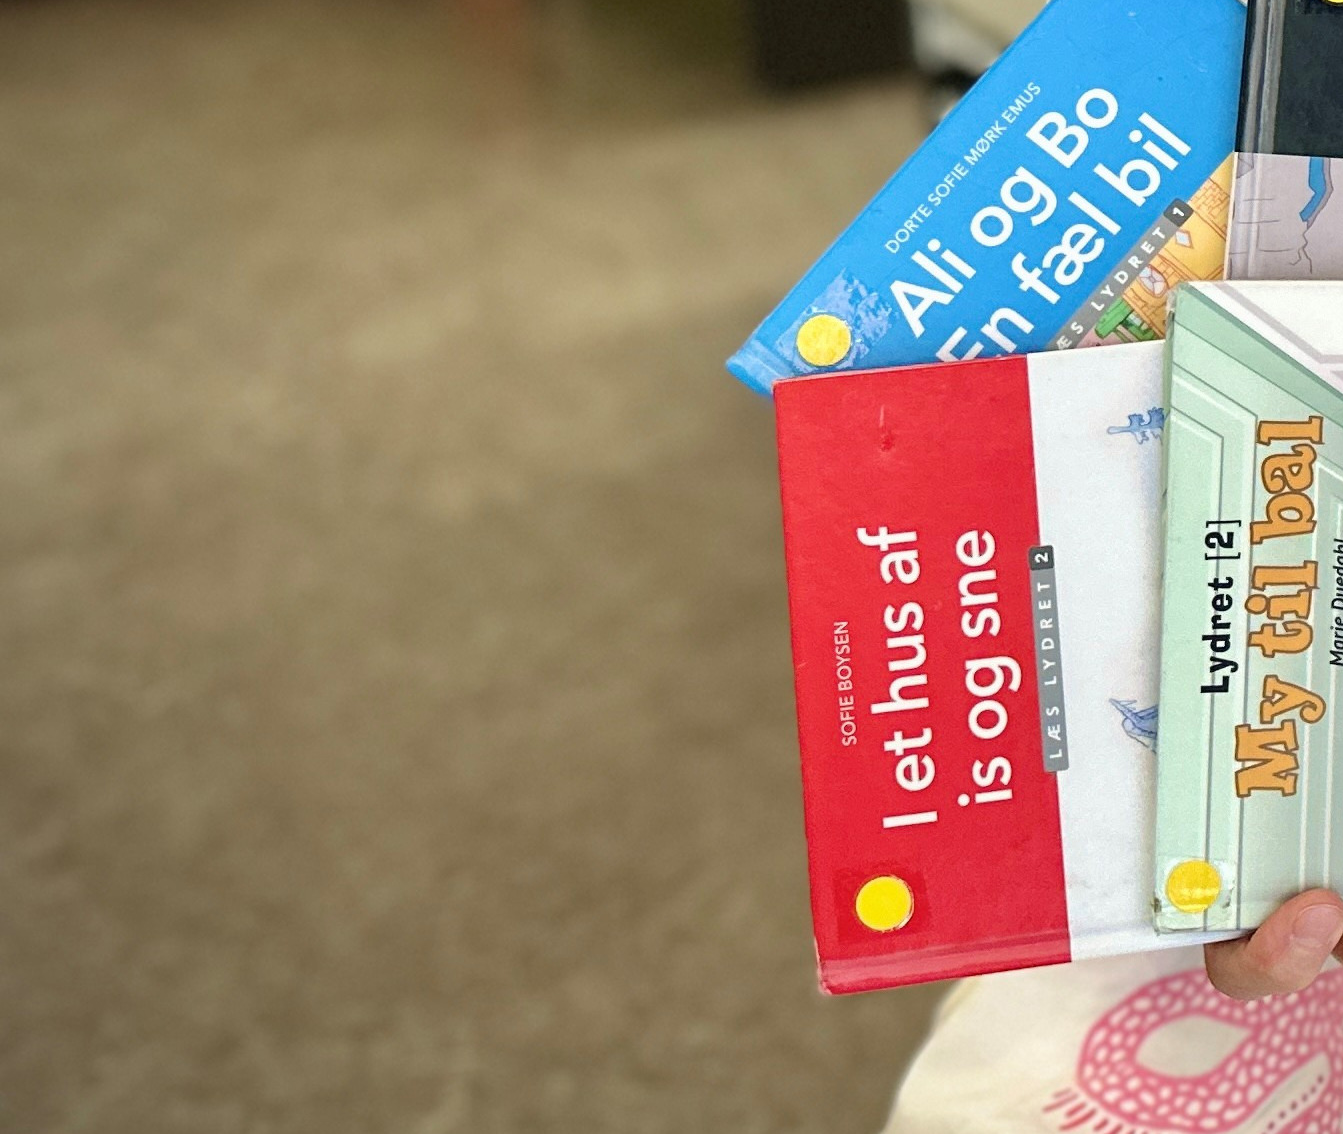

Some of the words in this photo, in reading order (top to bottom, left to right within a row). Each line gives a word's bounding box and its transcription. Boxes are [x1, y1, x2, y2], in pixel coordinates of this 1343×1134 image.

[885, 203, 933, 255] DORTE
[928, 162, 970, 206] SOFIE
[964, 120, 1008, 168] MØRK
[1001, 82, 1041, 126] EMUS
[889, 237, 977, 338] Ali
[970, 165, 1057, 247] og
[1026, 88, 1119, 168] Bo
[936, 307, 1034, 362] En
[1012, 191, 1121, 304] fæl
[1095, 112, 1191, 207] bil
[1056, 321, 1084, 350] ÆS
[1091, 226, 1166, 312] LYDRET
[1170, 207, 1184, 219] 1
[1250, 414, 1324, 545] bal
[857, 524, 921, 583] af
[955, 529, 1001, 639] sne
[833, 620, 853, 690] BOYSEN
[871, 601, 929, 715] hus
[1037, 580, 1058, 688] LYDRET
[1200, 575, 1238, 694] Lydret
[1244, 560, 1317, 657] til
[839, 692, 857, 746] SOFIE
[966, 656, 1021, 738] og
[1047, 705, 1064, 760] LÆS
[1235, 674, 1326, 798] My
[884, 727, 936, 791] et
[958, 755, 1013, 806] is
[883, 811, 937, 828] I
